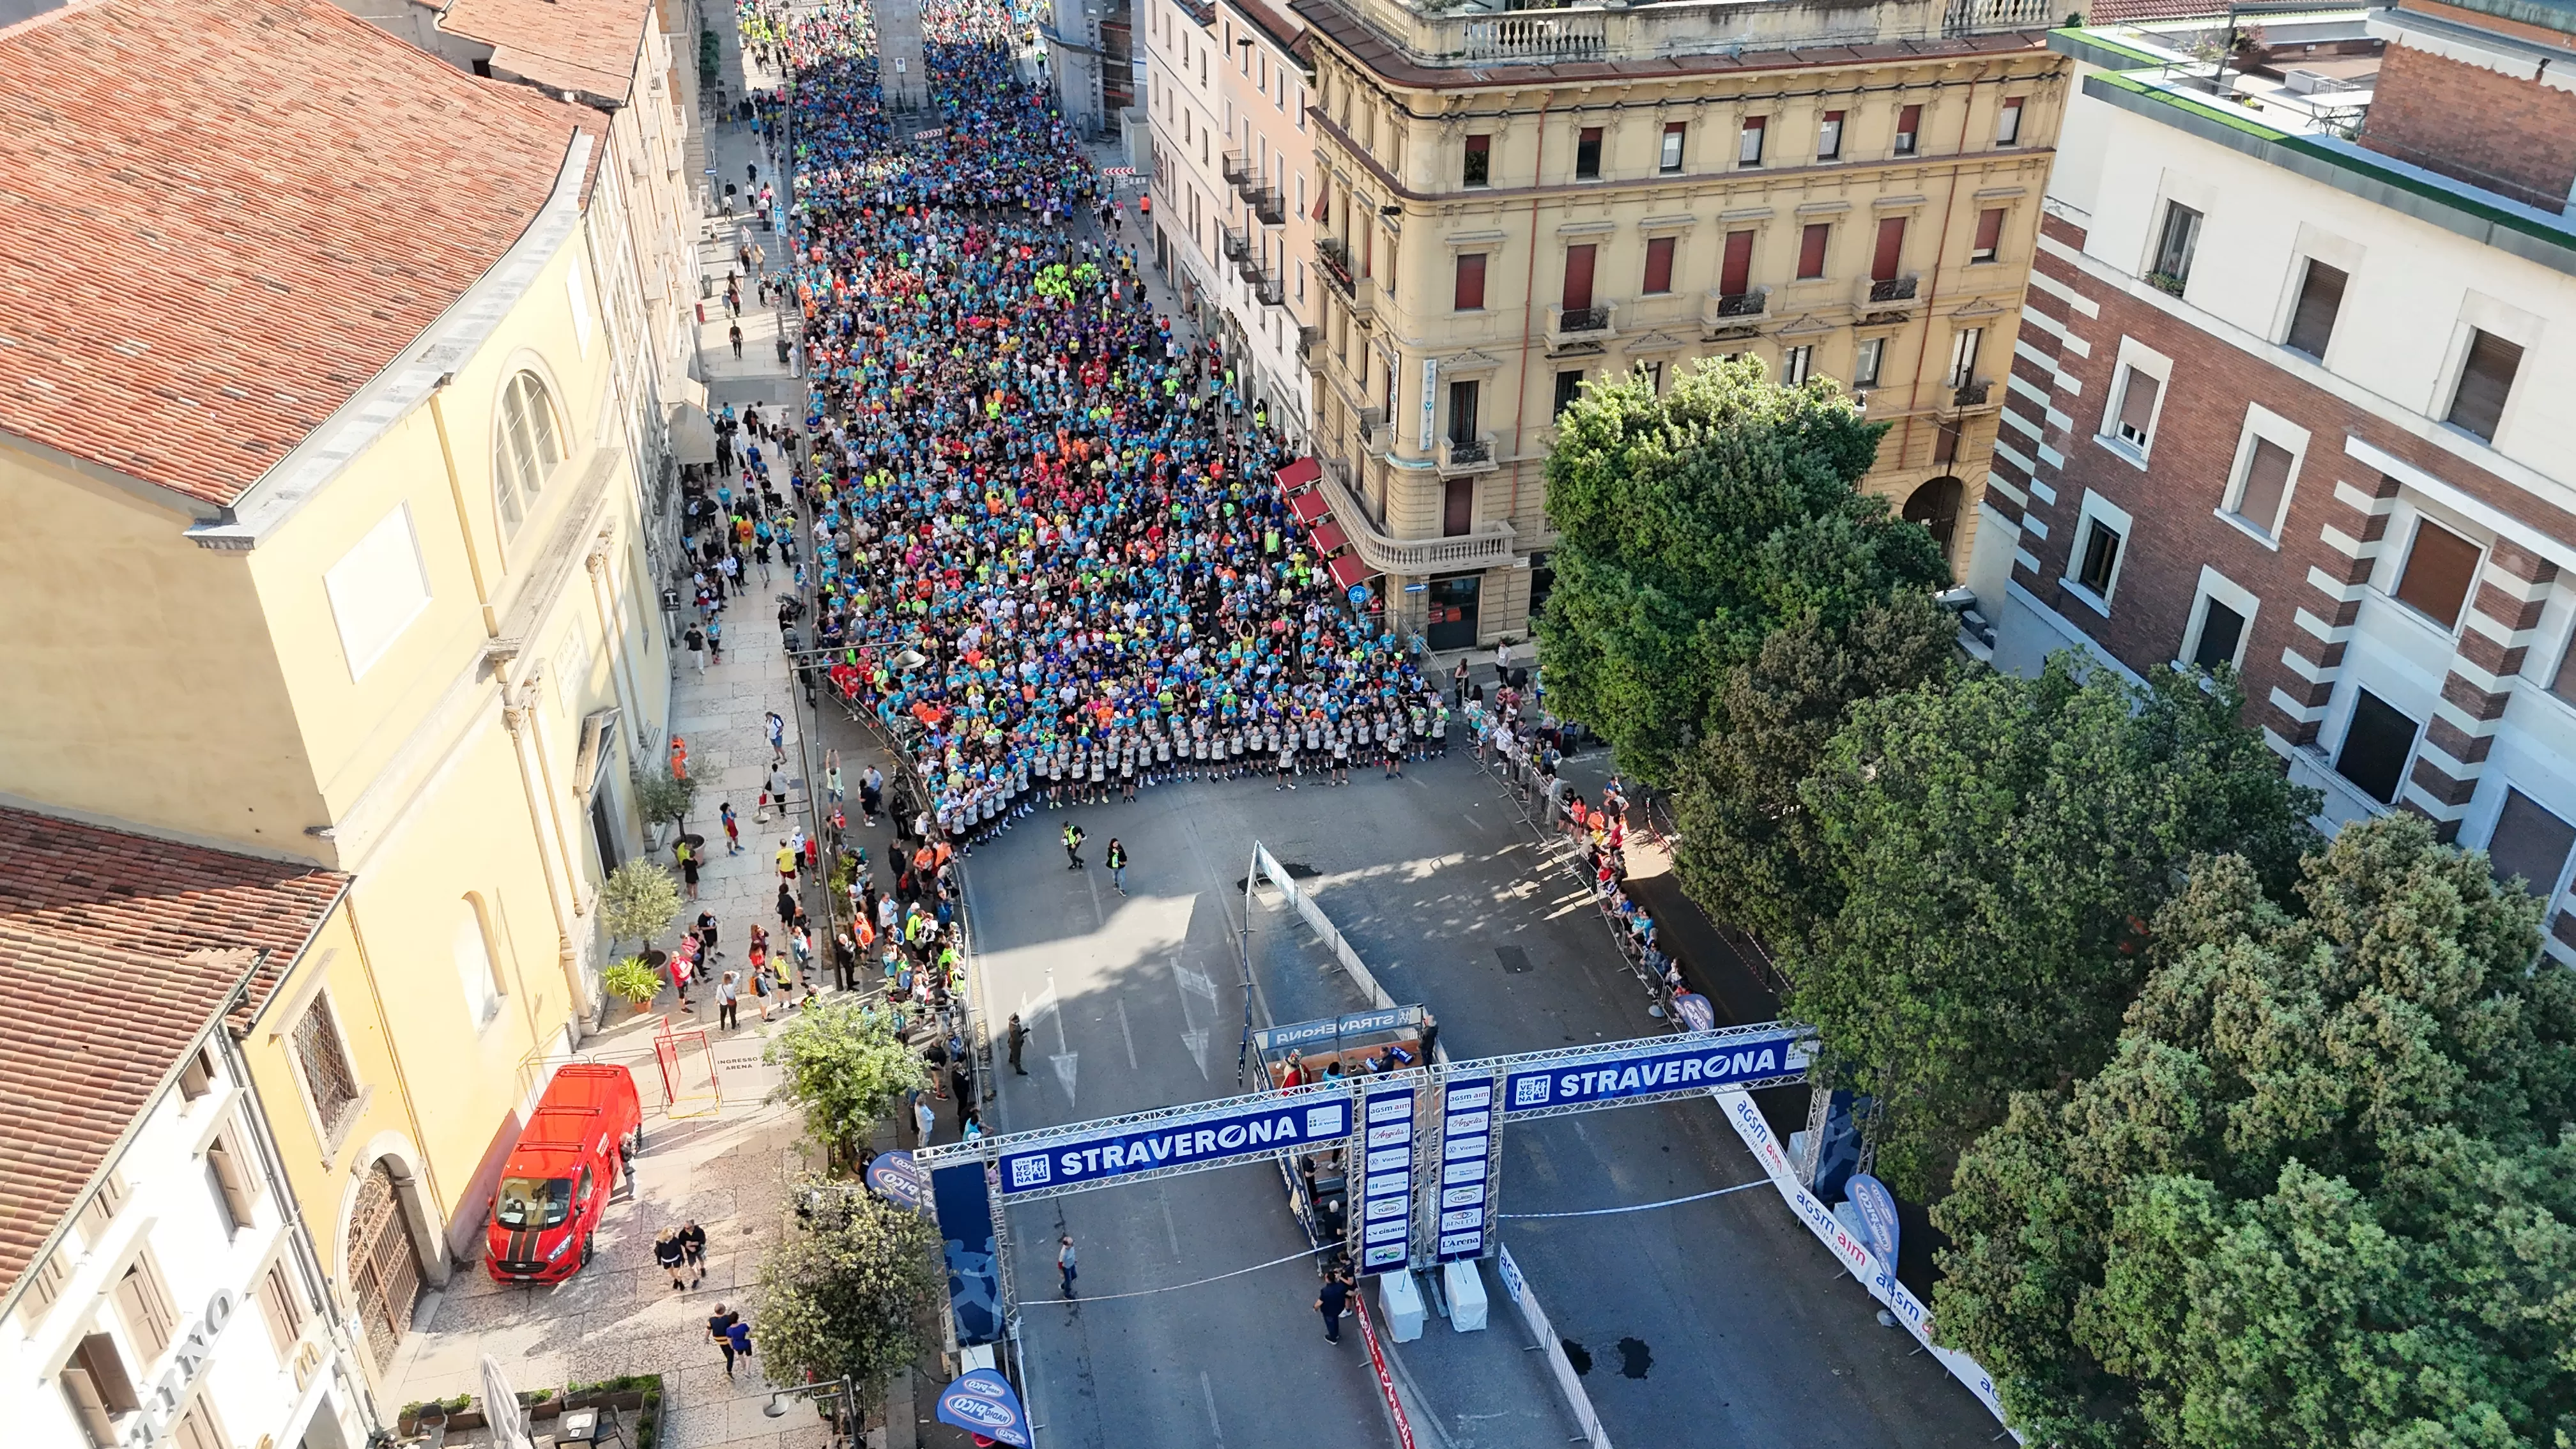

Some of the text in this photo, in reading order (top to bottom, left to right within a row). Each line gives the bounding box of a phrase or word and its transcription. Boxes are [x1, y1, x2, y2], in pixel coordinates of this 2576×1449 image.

[1560, 1048, 1775, 1097] STRAVERONA
[1061, 1116, 1298, 1176] STRAVERONA
[1460, 1142, 1485, 1151] Vicentini
[1742, 1128, 1759, 1150] MIGLIORI
[1758, 1150, 1774, 1172] ENERGIE
[1443, 1237, 1479, 1248] L'Arena
[1446, 1218, 1477, 1227] BENETTI
[1811, 1220, 1832, 1245] MIGLIORI
[1832, 1242, 1851, 1265] ENERGIE
[121, 1288, 234, 1449] TINO
